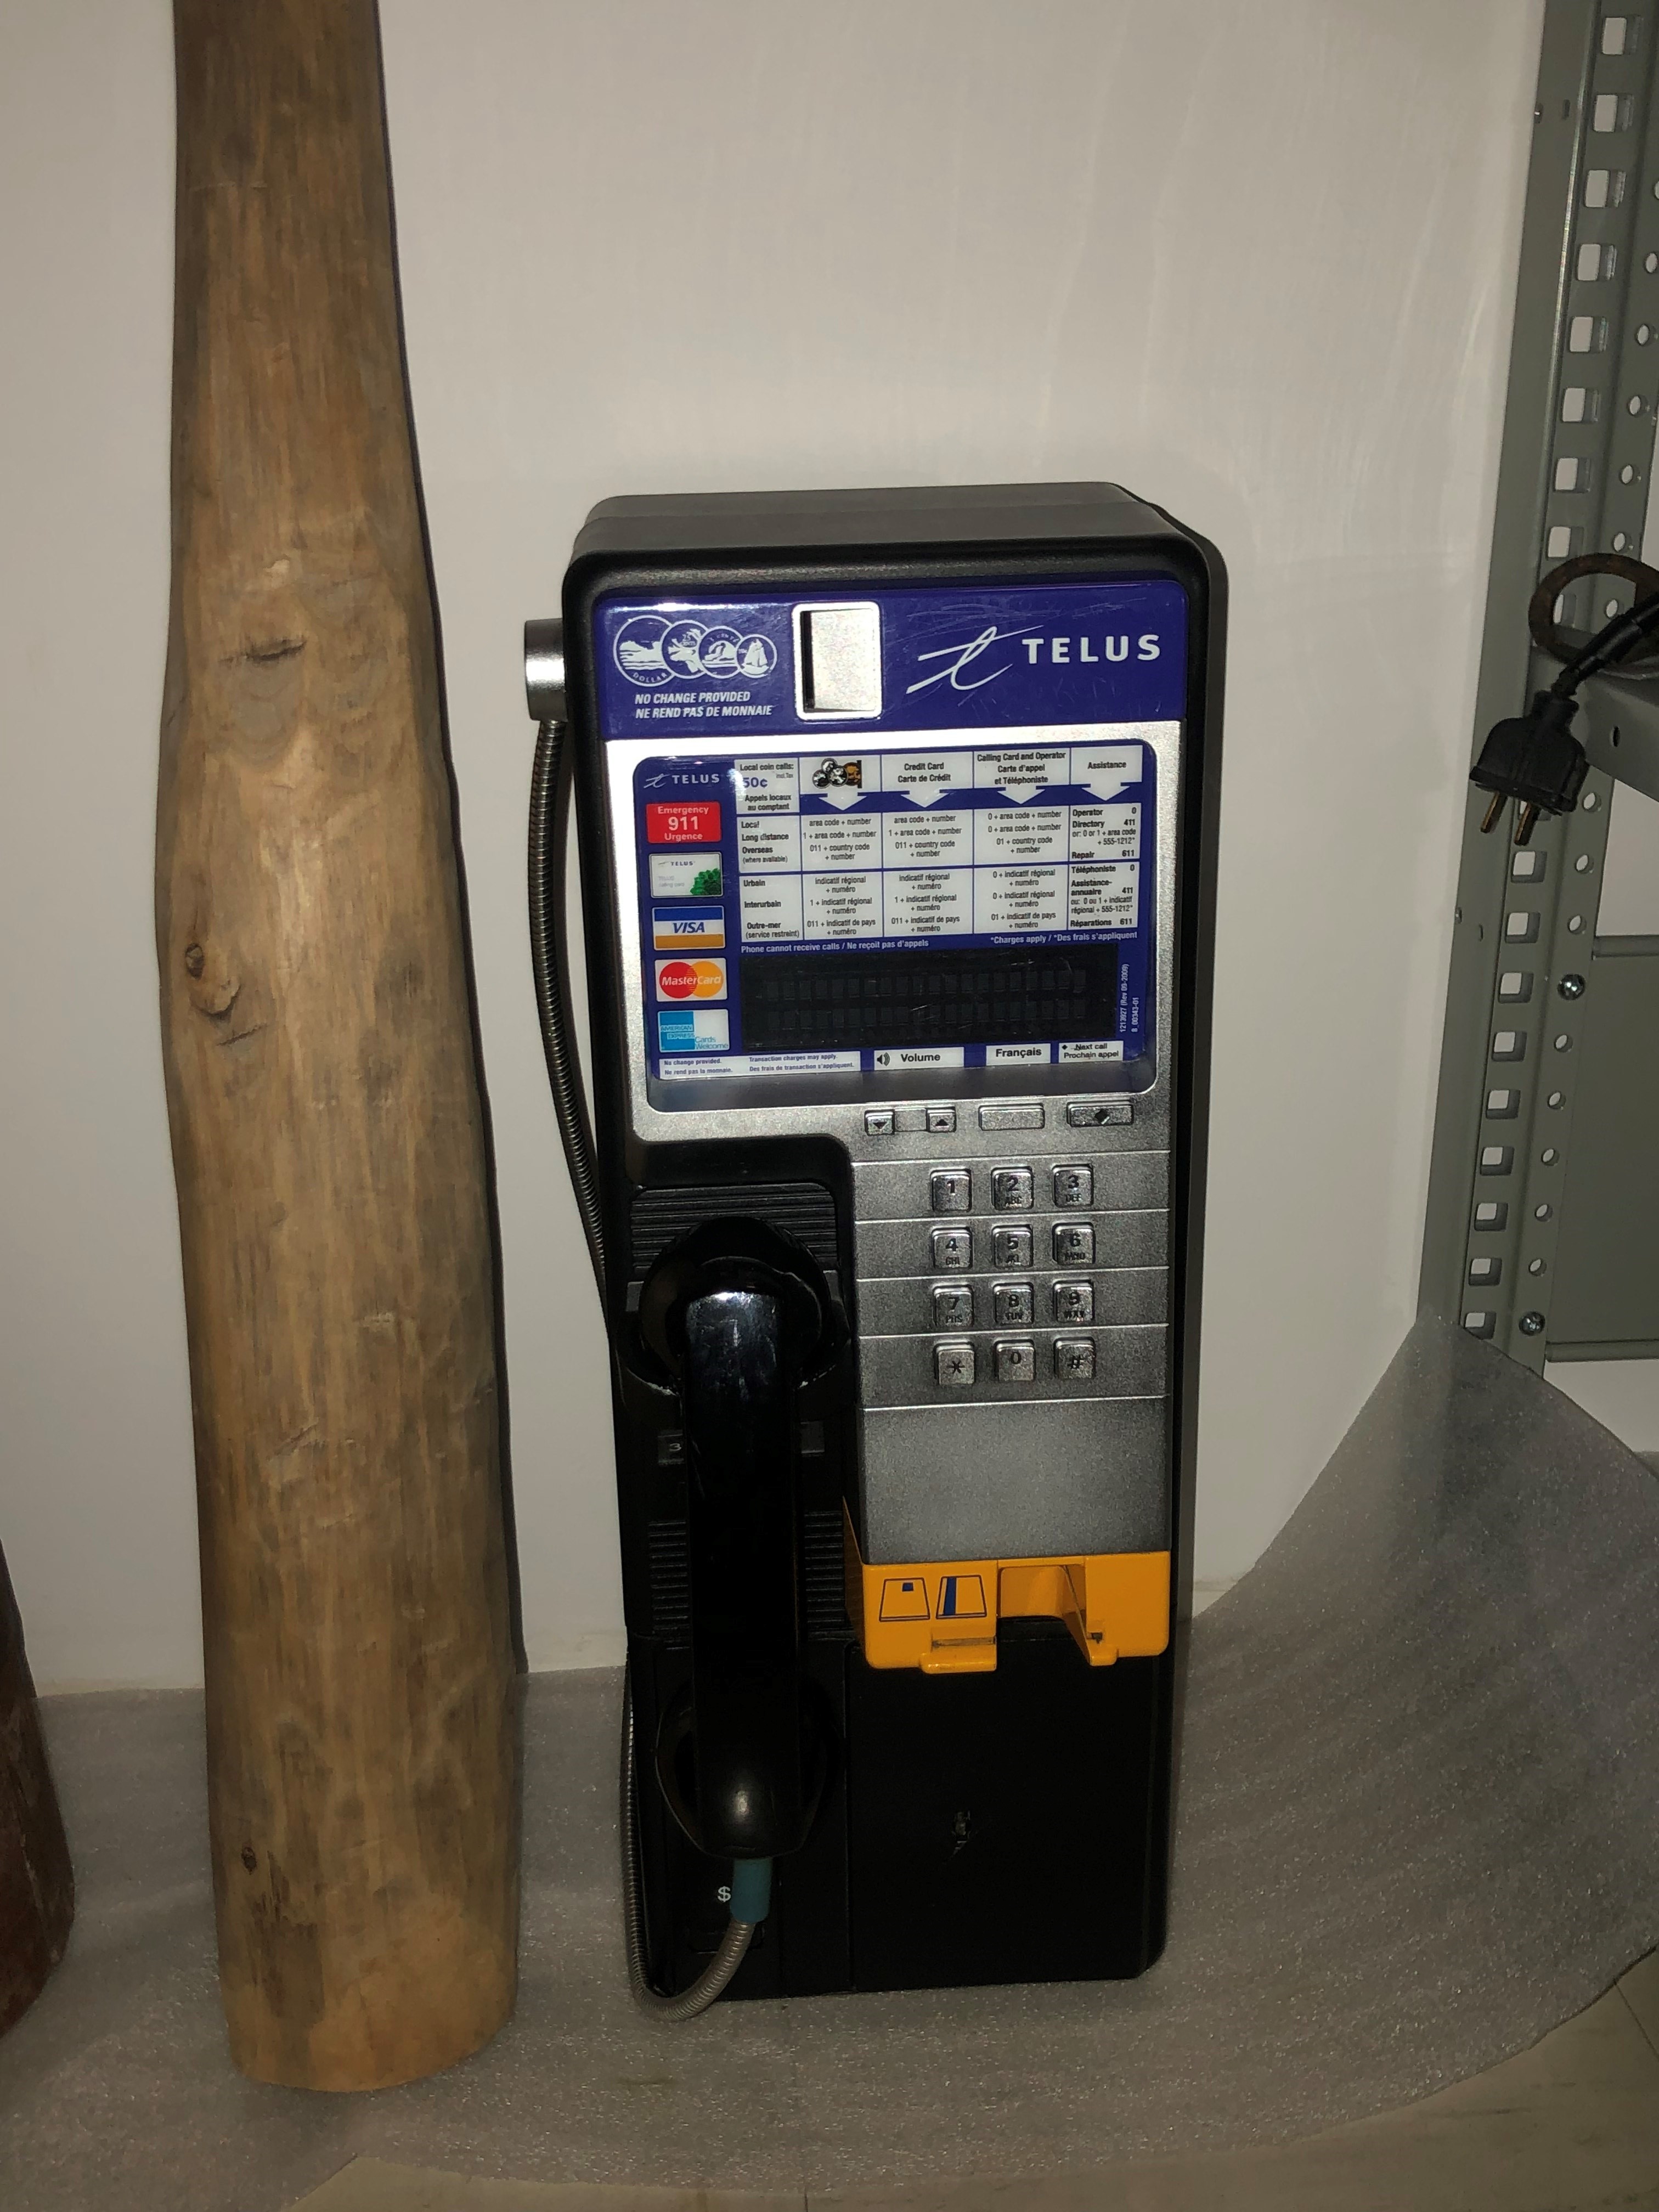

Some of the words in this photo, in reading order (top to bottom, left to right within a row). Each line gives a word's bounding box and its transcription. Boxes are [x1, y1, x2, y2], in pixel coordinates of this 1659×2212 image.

[1022, 634, 1161, 665] TELUS
[633, 672, 667, 683] DOLLAR
[635, 694, 651, 704] NO
[654, 693, 696, 703] CHANGE
[698, 691, 750, 702] PROVIDED
[636, 708, 651, 719] NE
[653, 708, 680, 718] REND
[684, 707, 703, 717] PAS
[706, 706, 720, 716] DE
[722, 705, 772, 716] MONNAIE
[977, 754, 1001, 763] Calling
[672, 774, 720, 783] TELUS
[1004, 776, 1048, 785] Téléphoniste
[658, 806, 709, 816] Emergency
[1073, 809, 1103, 817] Operator
[668, 816, 698, 831] 911
[664, 833, 702, 843] Urgence
[915, 840, 938, 849] country
[1071, 866, 1116, 874] Téléphoniste
[673, 922, 705, 933] VISA
[822, 943, 839, 951] calls
[859, 940, 879, 950] reçoit
[898, 940, 929, 949] d'appels
[1026, 935, 1046, 944] apply
[662, 975, 721, 985] MasterCard
[901, 1052, 940, 1062] Volume
[996, 1048, 1041, 1058] Français
[947, 1180, 955, 1193] 1
[1008, 1176, 1018, 1192] 2
[1068, 1175, 1079, 1188] 3
[946, 1238, 958, 1252] 4
[1008, 1235, 1018, 1249] 5
[1070, 1233, 1081, 1247] 6
[949, 1297, 960, 1310] 7
[1009, 1294, 1019, 1307] 8
[1070, 1292, 1080, 1305] 9
[1011, 1352, 1021, 1364] 0
[1068, 1356, 1084, 1369] #
[718, 1886, 731, 1903] $
